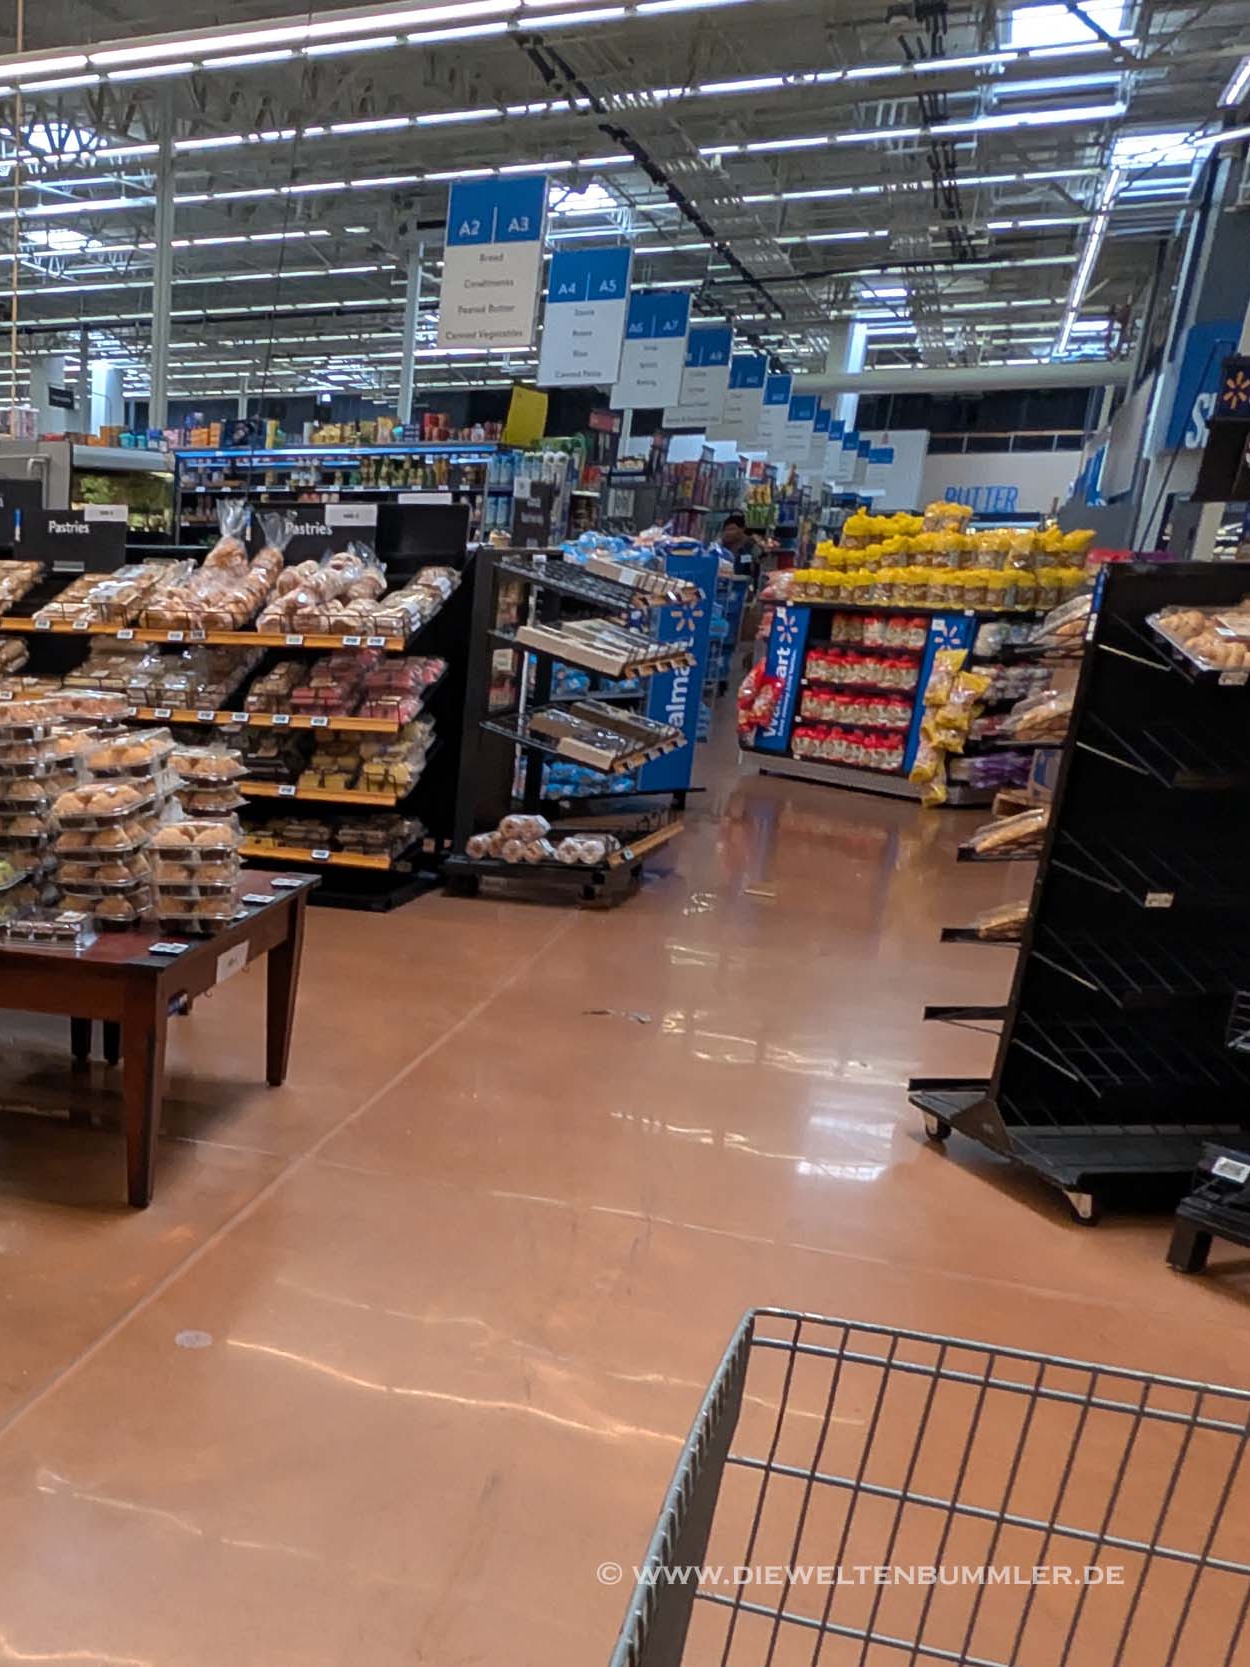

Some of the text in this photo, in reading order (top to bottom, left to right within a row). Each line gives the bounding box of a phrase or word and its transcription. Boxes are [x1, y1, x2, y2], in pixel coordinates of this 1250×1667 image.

[459, 217, 529, 236] A2 A3
[558, 280, 617, 295] A4 A5
[663, 320, 678, 331] A7
[48, 520, 90, 534] Pastries
[284, 522, 333, 535] Pastries
